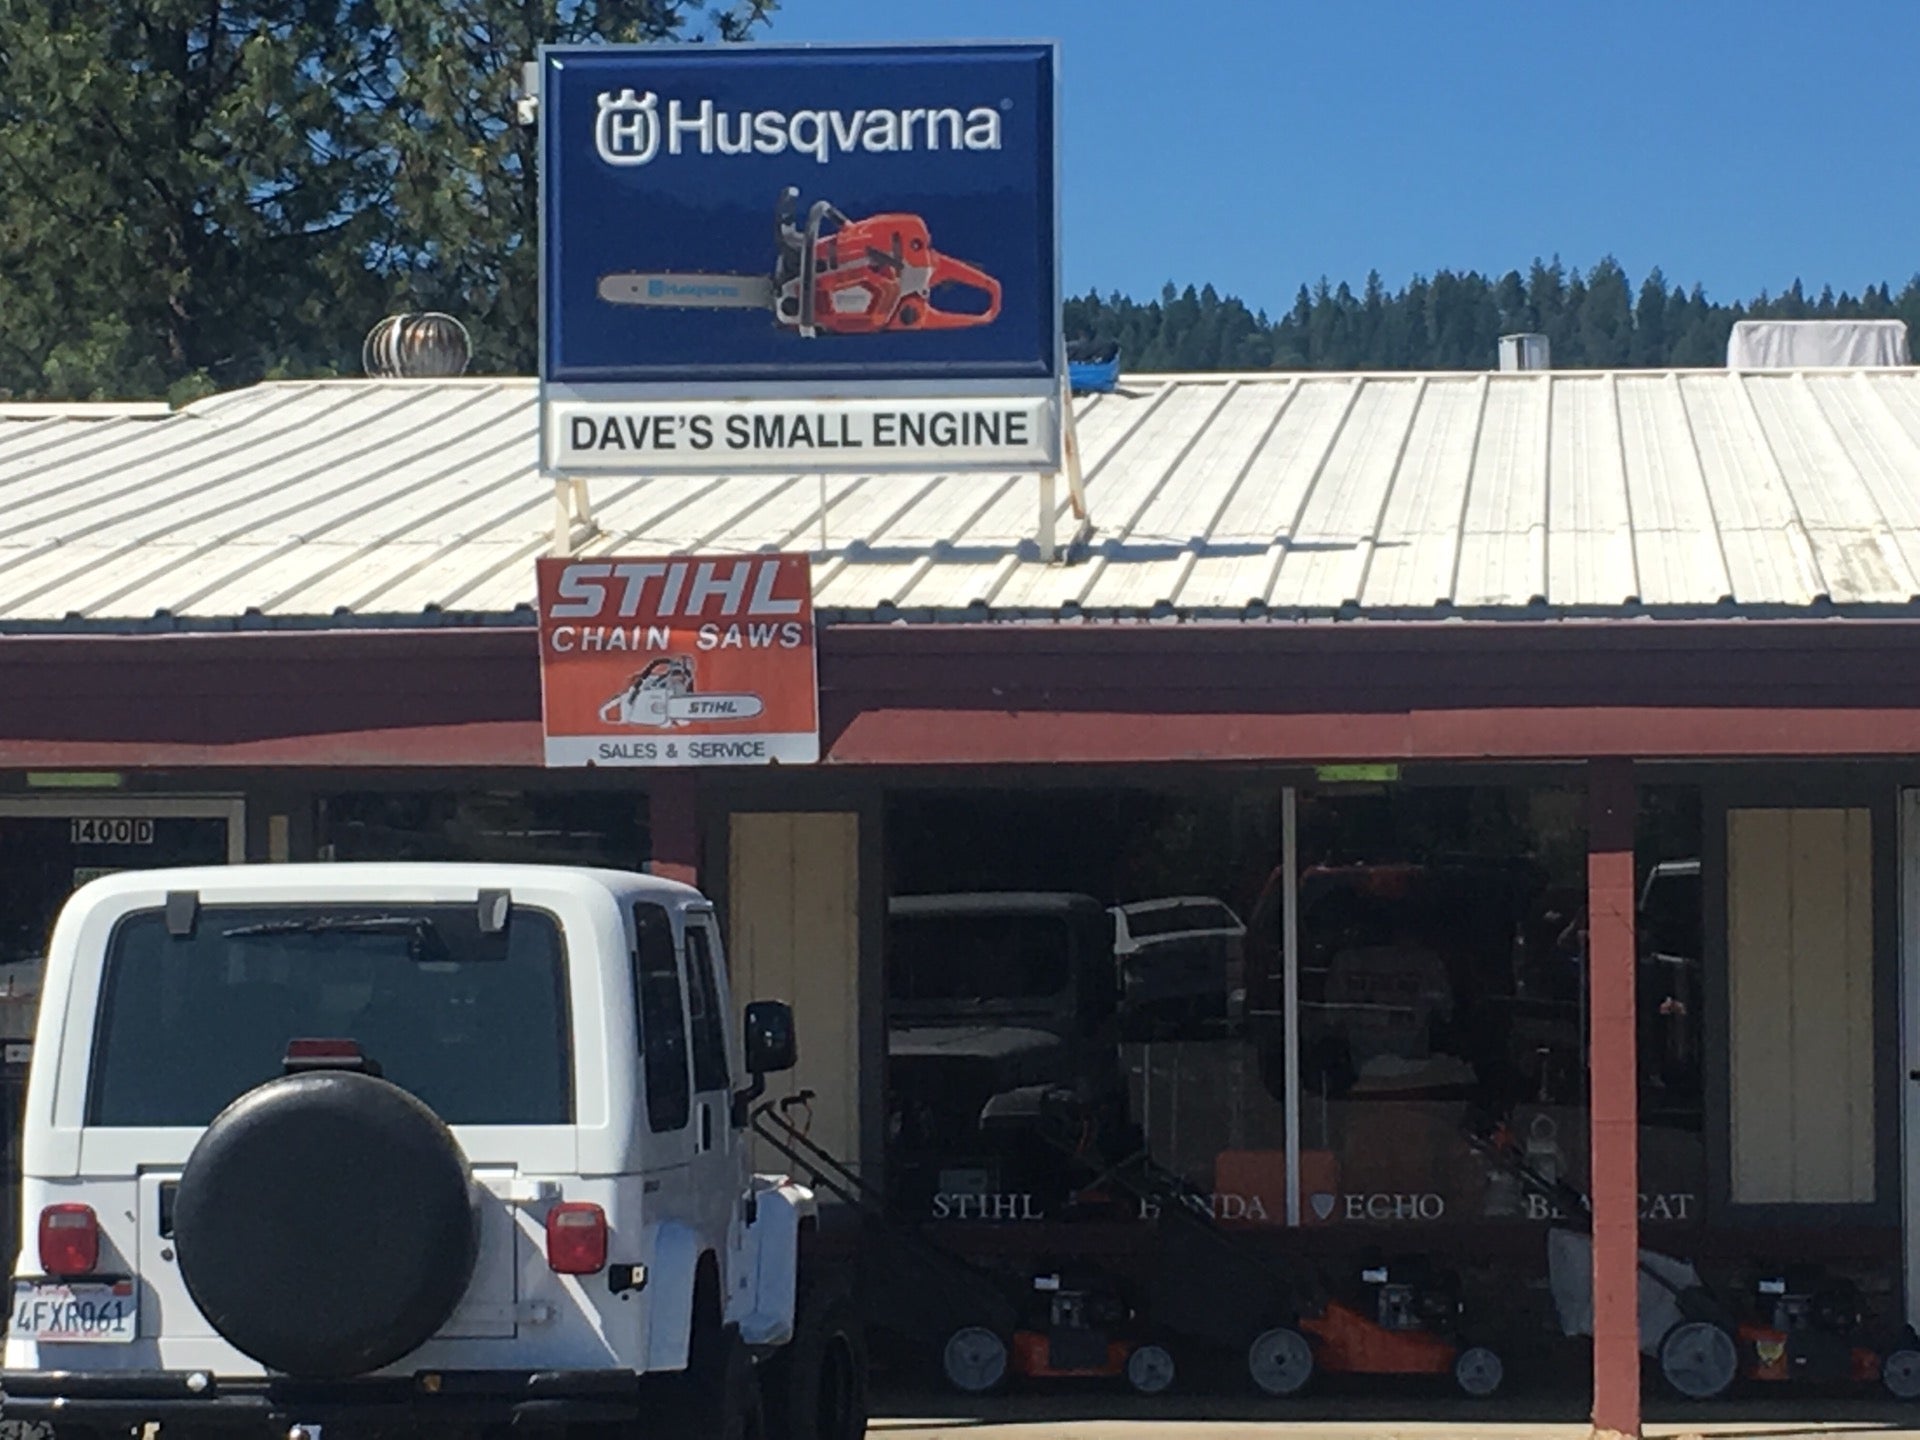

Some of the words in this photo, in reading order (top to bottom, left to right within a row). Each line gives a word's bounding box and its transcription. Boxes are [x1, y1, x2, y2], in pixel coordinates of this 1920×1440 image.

[668, 100, 1002, 163] Husqvarna
[571, 415, 714, 451] DAVE'S
[726, 413, 864, 448] SMALL
[872, 411, 1029, 446] ENGINE
[549, 560, 803, 618] STIHL
[551, 625, 671, 652] CHAIN
[696, 622, 804, 651] SAWS
[687, 701, 738, 714] STIHL
[599, 743, 658, 761] SALES
[665, 742, 679, 758] &
[687, 741, 766, 759] SERVICE
[931, 1192, 1044, 1218] STIHL
[1138, 1192, 1269, 1219] HNDA
[1344, 1192, 1445, 1219] ECHO
[16, 1302, 126, 1332] 4FXR061
